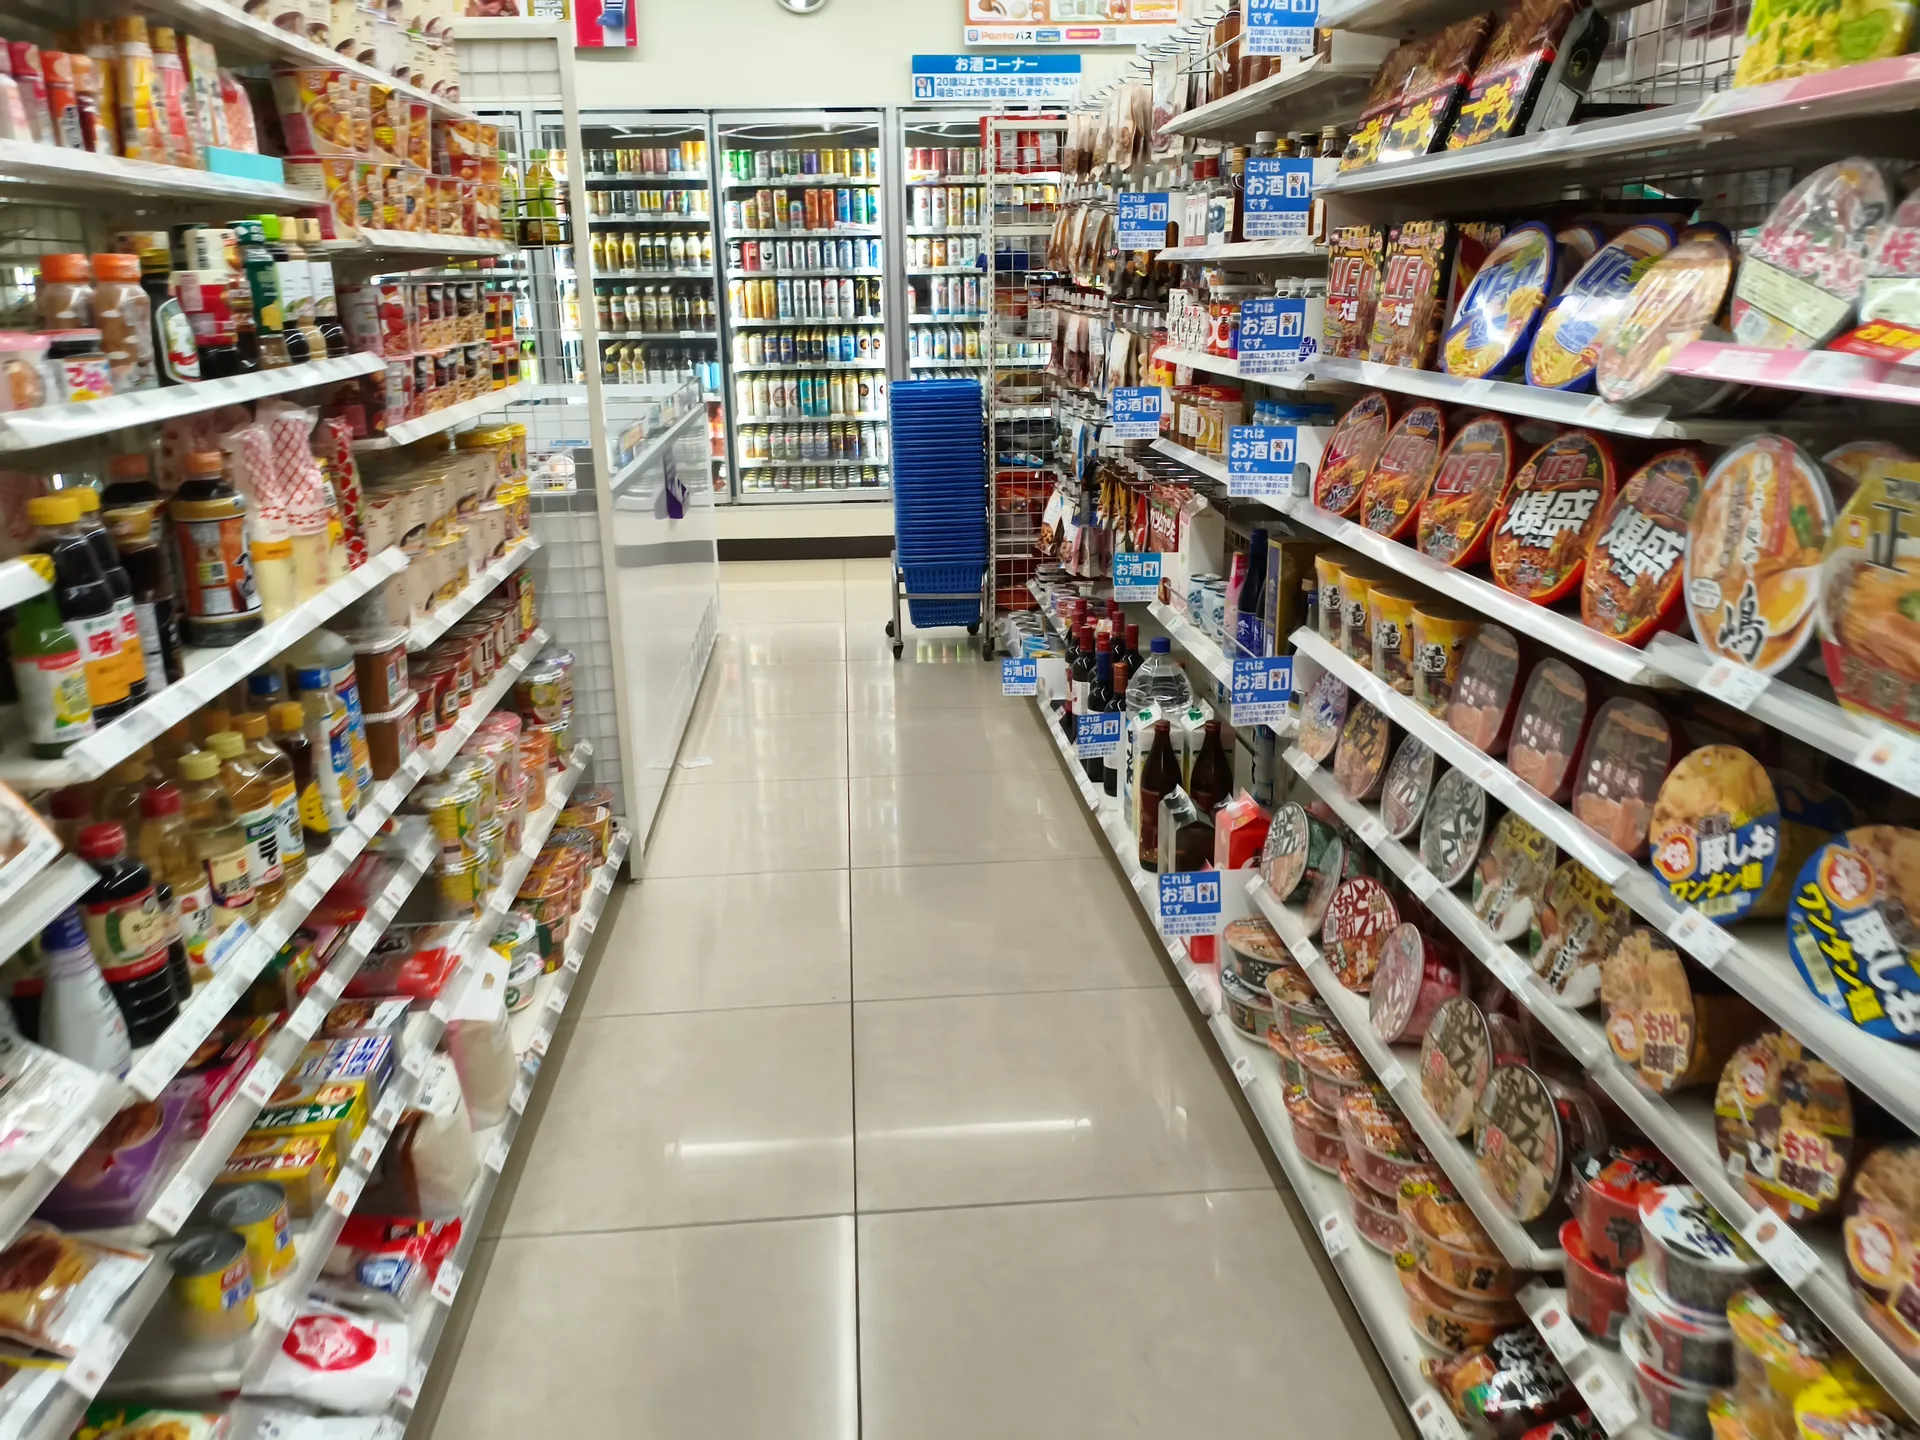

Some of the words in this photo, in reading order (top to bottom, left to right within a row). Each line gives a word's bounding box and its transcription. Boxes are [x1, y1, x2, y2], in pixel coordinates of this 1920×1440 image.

[1250, 12, 1278, 25] です。
[954, 57, 1039, 72] お酒コーナー
[936, 76, 1079, 87] 20歳以上であることを確認できない
[936, 87, 1056, 98] 場合にはお酒を販売しません。
[1248, 161, 1281, 172] これは
[1246, 175, 1284, 197] お酒
[1121, 194, 1146, 204] これは
[1247, 199, 1274, 210] です。
[1121, 204, 1149, 220] お酒
[1121, 222, 1141, 230] です。
[1243, 302, 1275, 314] これは
[1241, 315, 1278, 336] お酒
[1241, 338, 1267, 349] です。
[1115, 389, 1139, 397] これは
[1115, 398, 1142, 412] お酒
[1115, 413, 1135, 421] です。
[1232, 428, 1265, 439] これは
[1231, 441, 1268, 460] お酒
[1230, 461, 1258, 472] です。
[1498, 488, 1600, 536] 爆盛
[1597, 504, 1686, 586] 爆盛
[1116, 554, 1139, 562] これは
[1115, 563, 1142, 576] お酒
[1115, 577, 1136, 585] です。
[1235, 660, 1264, 671] これは
[1003, 667, 1022, 676] お酒
[1233, 672, 1267, 691] お酒
[1234, 690, 1258, 702] です。
[1079, 715, 1100, 723] これは
[1078, 723, 1102, 735] お酒
[1078, 736, 1096, 744] です。
[1161, 874, 1192, 885] これは
[1161, 885, 1196, 902] お酒
[1162, 904, 1188, 914] です。
[1643, 1011, 1688, 1046] もやし
[1783, 1129, 1836, 1175] もやし
